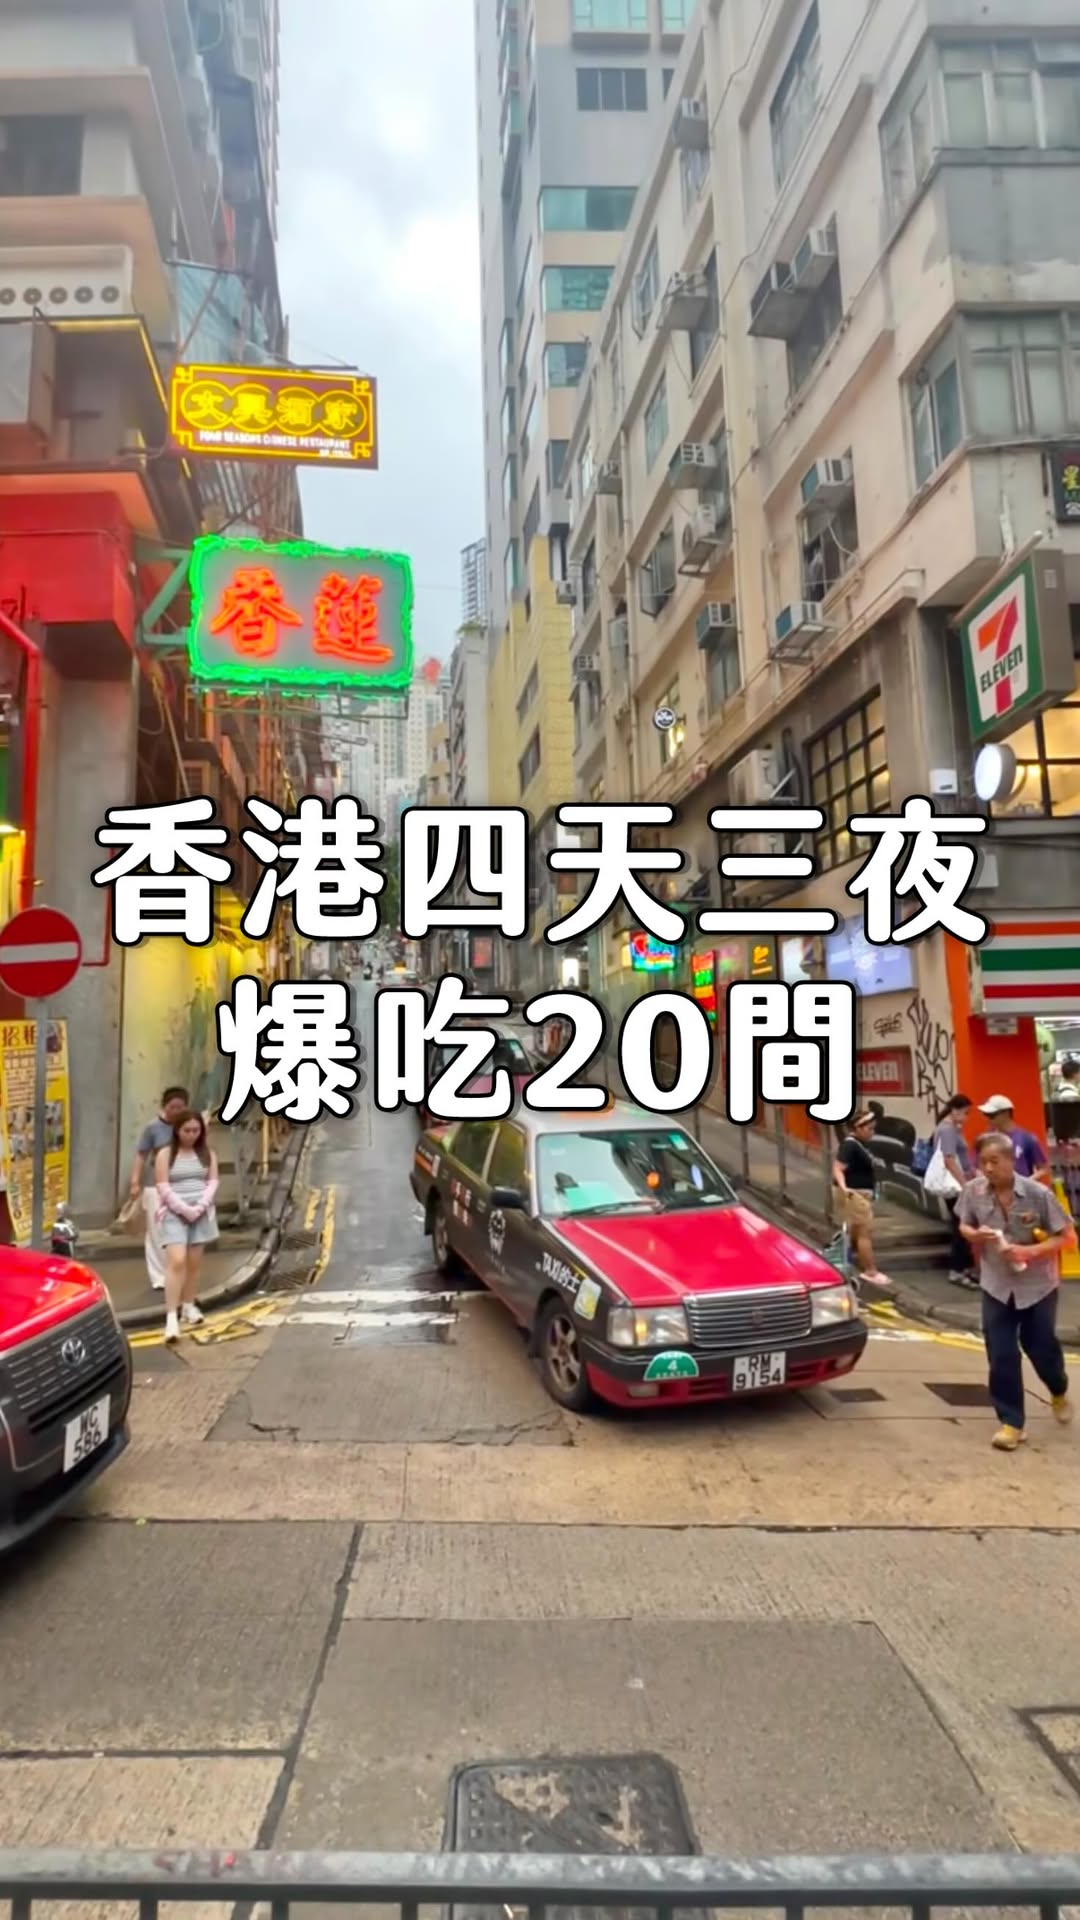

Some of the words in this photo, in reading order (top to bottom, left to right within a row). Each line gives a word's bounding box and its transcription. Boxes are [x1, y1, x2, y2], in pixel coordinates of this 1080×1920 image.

[749, 1353, 771, 1371] RM
[735, 1368, 782, 1390] 9154
[73, 1430, 102, 1463] 586
